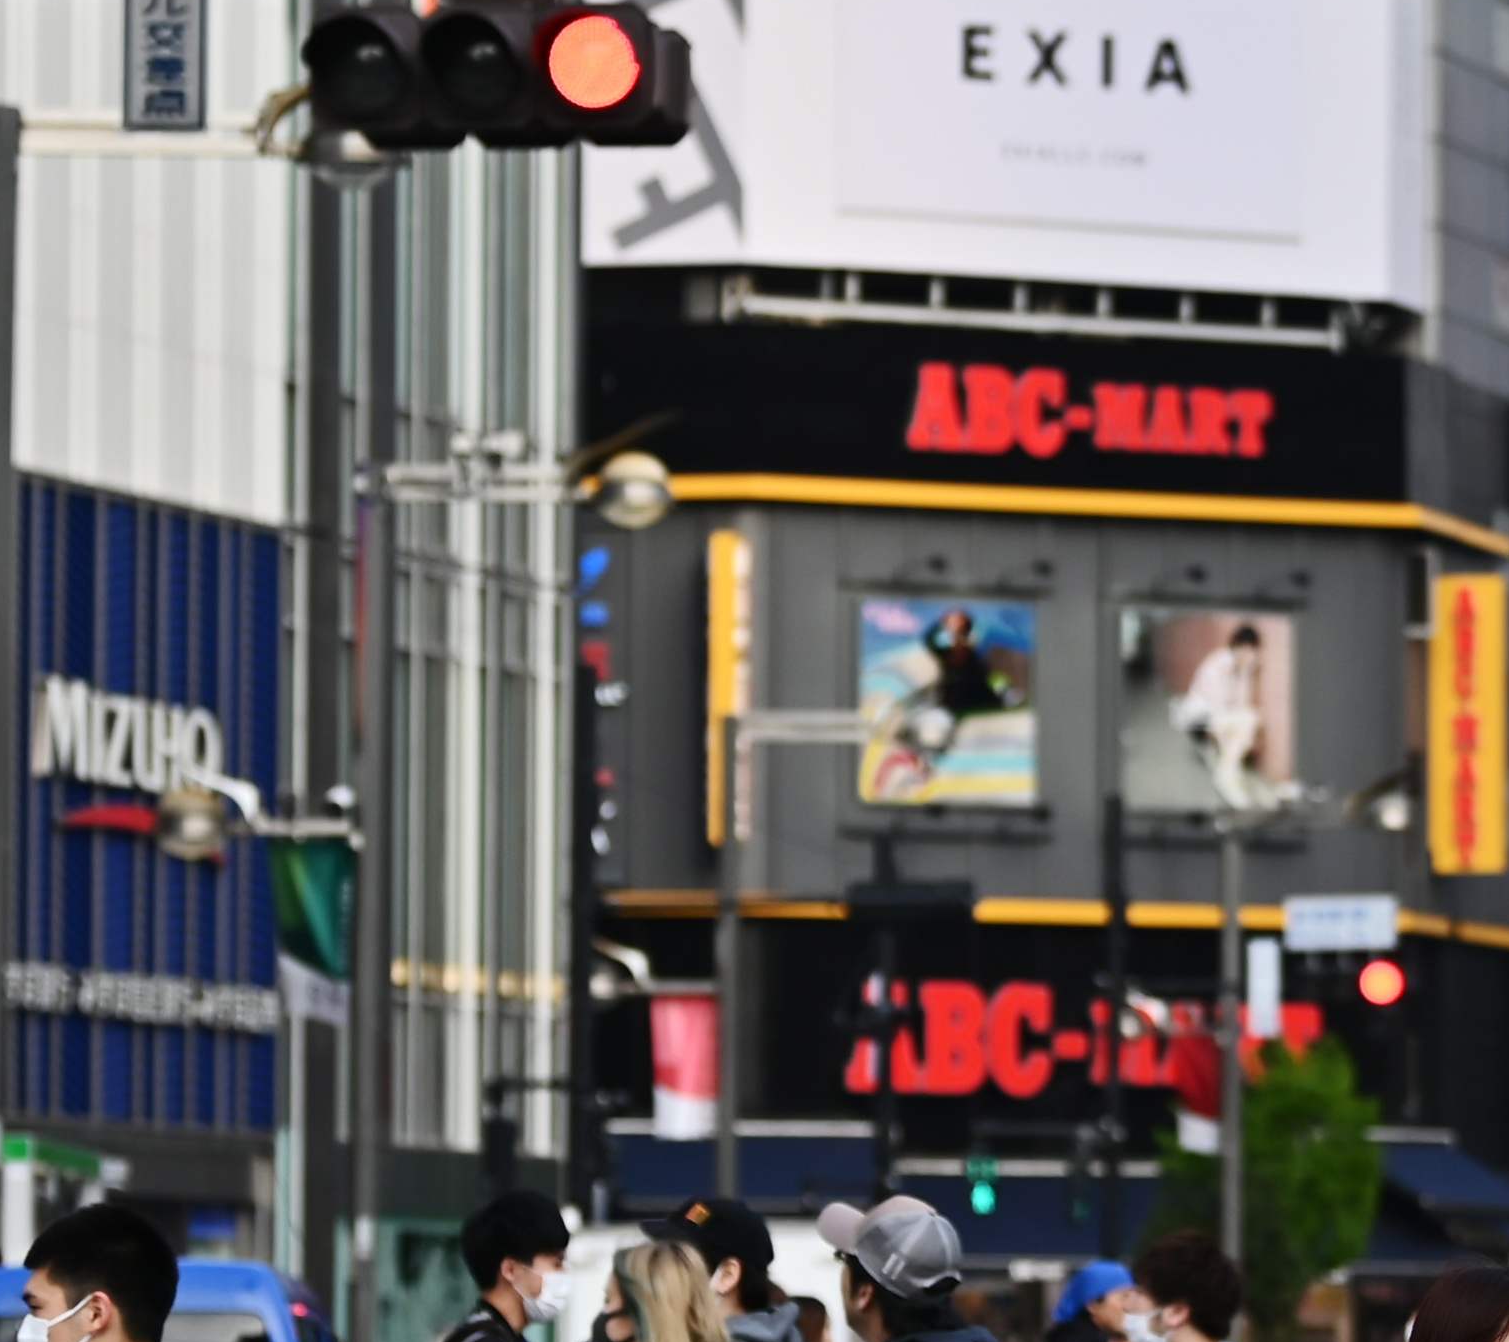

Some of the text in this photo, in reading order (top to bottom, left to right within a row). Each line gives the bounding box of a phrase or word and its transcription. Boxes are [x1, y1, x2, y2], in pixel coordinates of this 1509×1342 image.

[960, 25, 1191, 96] EXIA
[906, 362, 1275, 458] ABC-MART
[34, 672, 224, 792] MIZUHO
